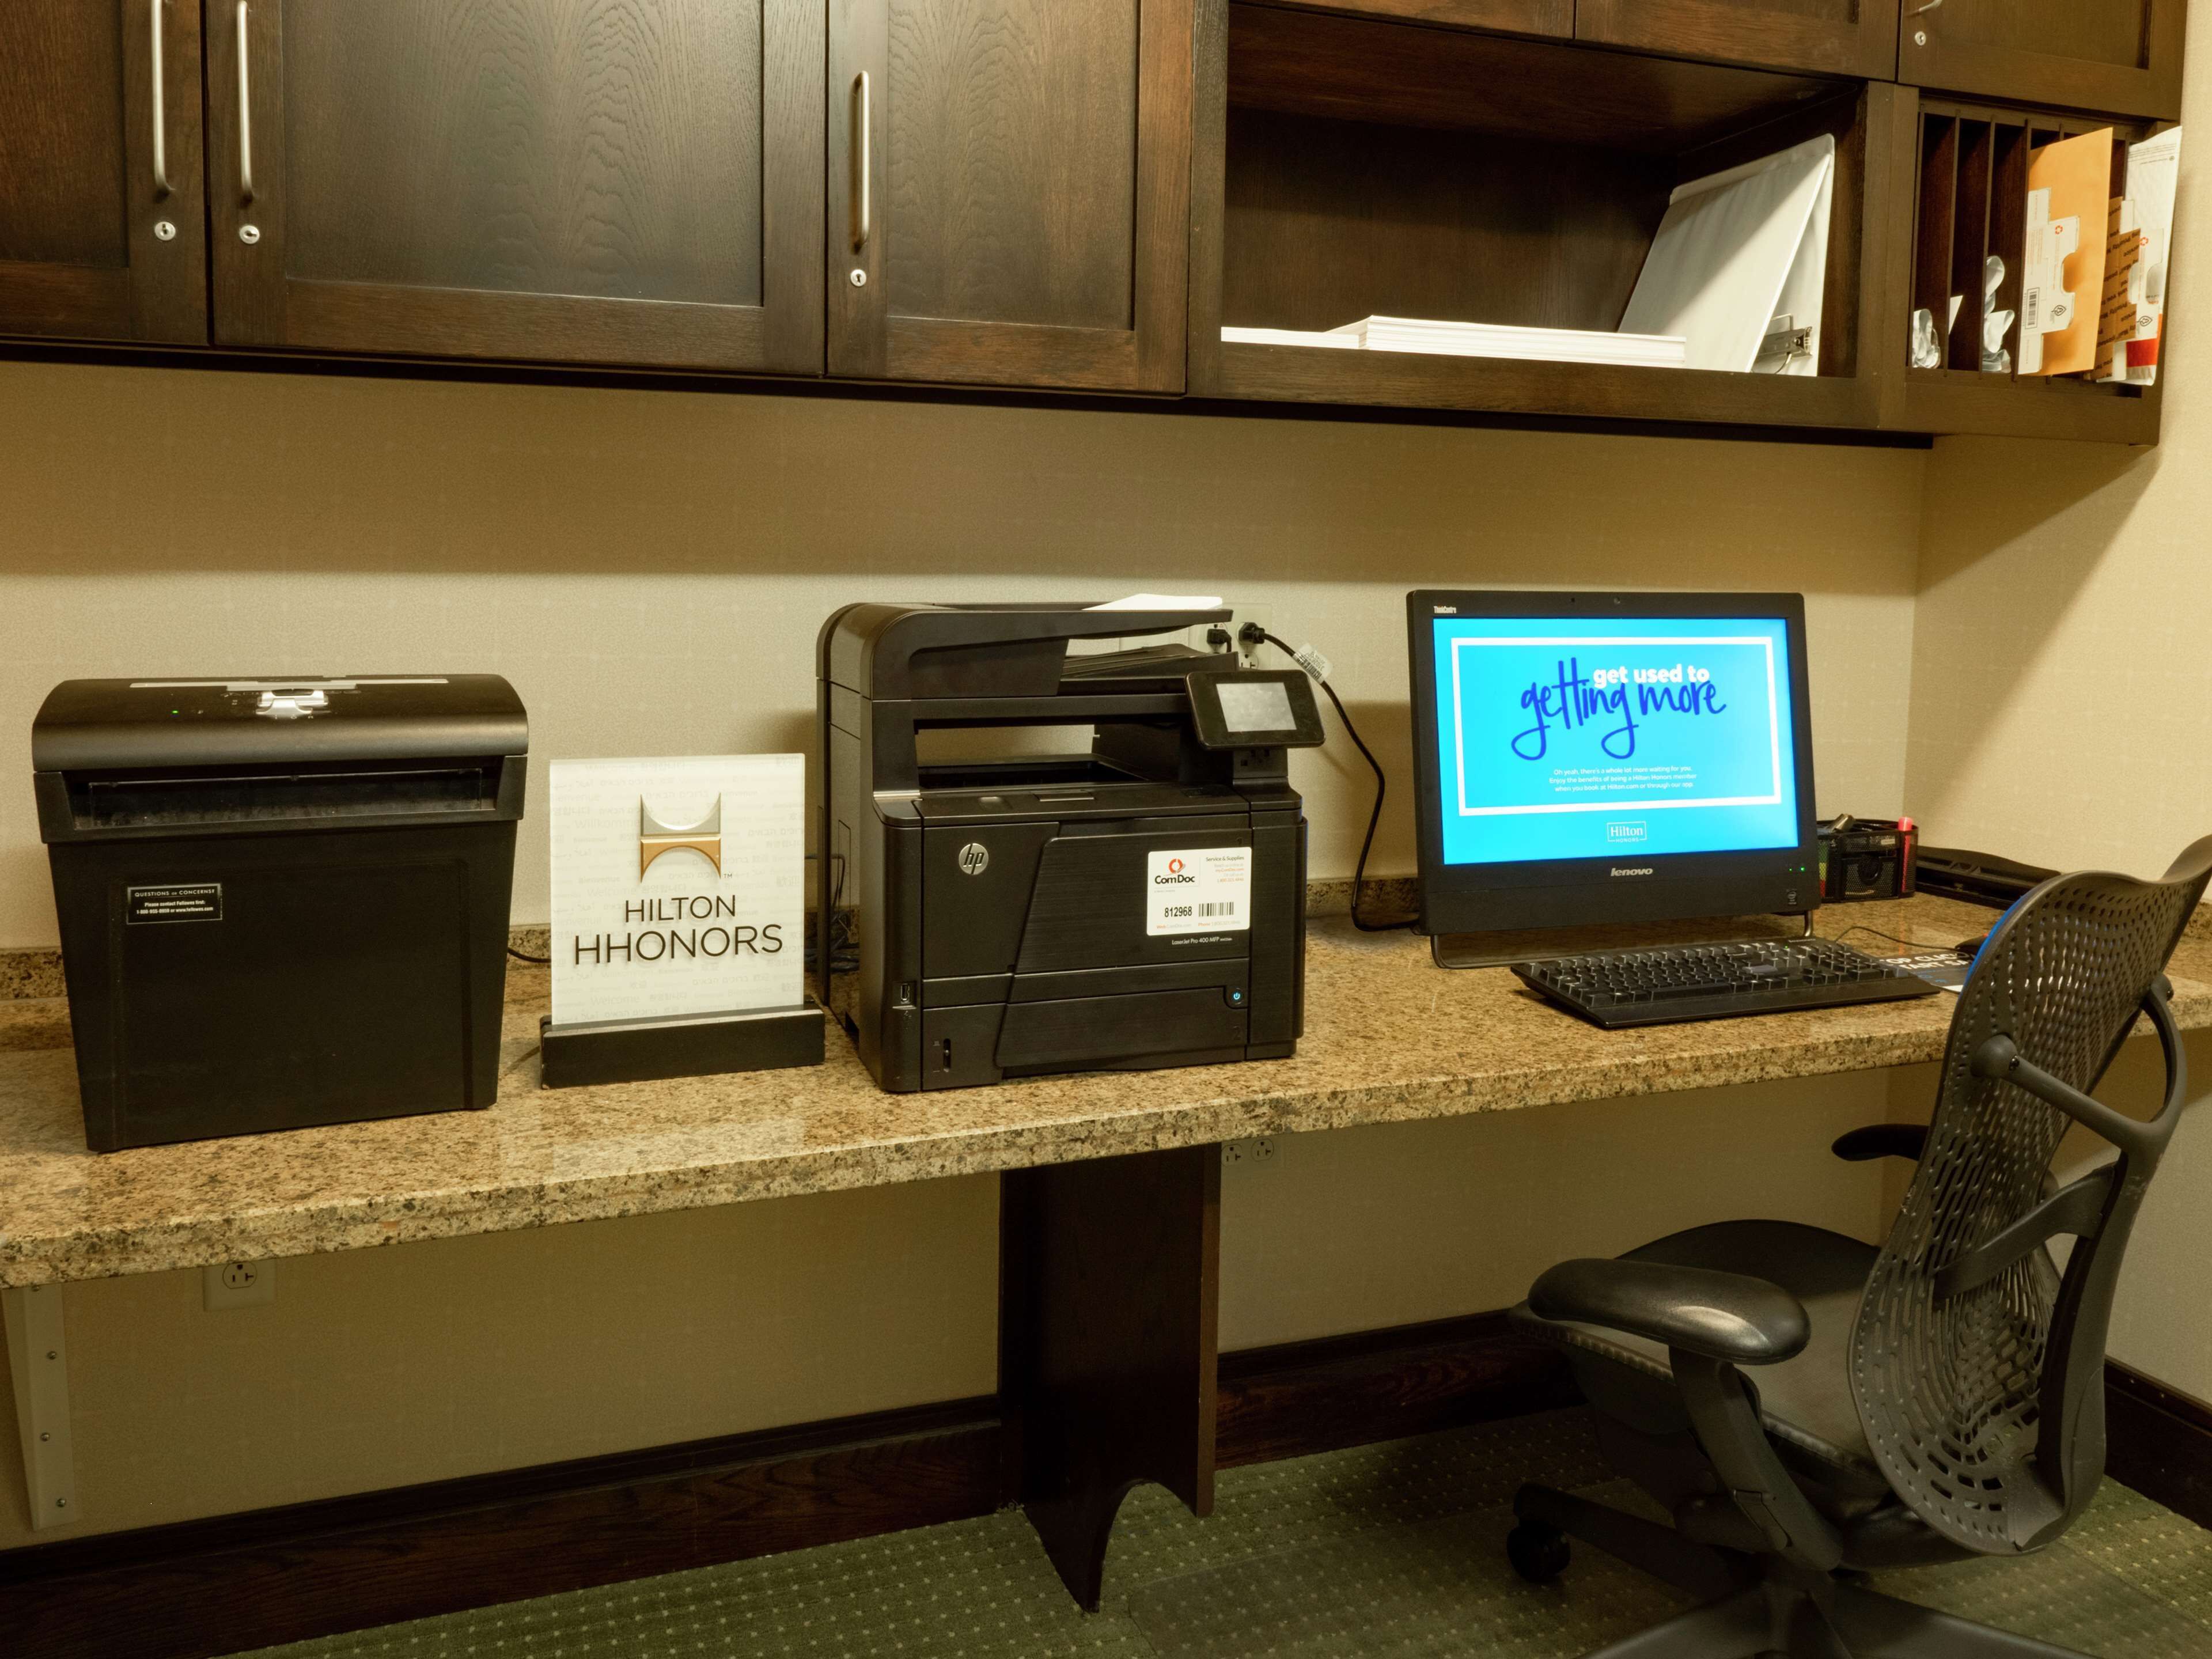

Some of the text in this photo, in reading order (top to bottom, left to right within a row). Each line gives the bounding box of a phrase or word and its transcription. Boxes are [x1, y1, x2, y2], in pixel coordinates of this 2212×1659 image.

[1593, 664, 1710, 688] get used to
[1512, 657, 1727, 760] getting more
[1610, 826, 1643, 836] Hilton
[963, 843, 985, 874] hp
[1154, 874, 1195, 884] ComDoc
[1610, 868, 1653, 877] lenovo
[625, 895, 736, 922] HILTON
[1164, 906, 1192, 917] 812968
[575, 924, 783, 965] HHONORS
